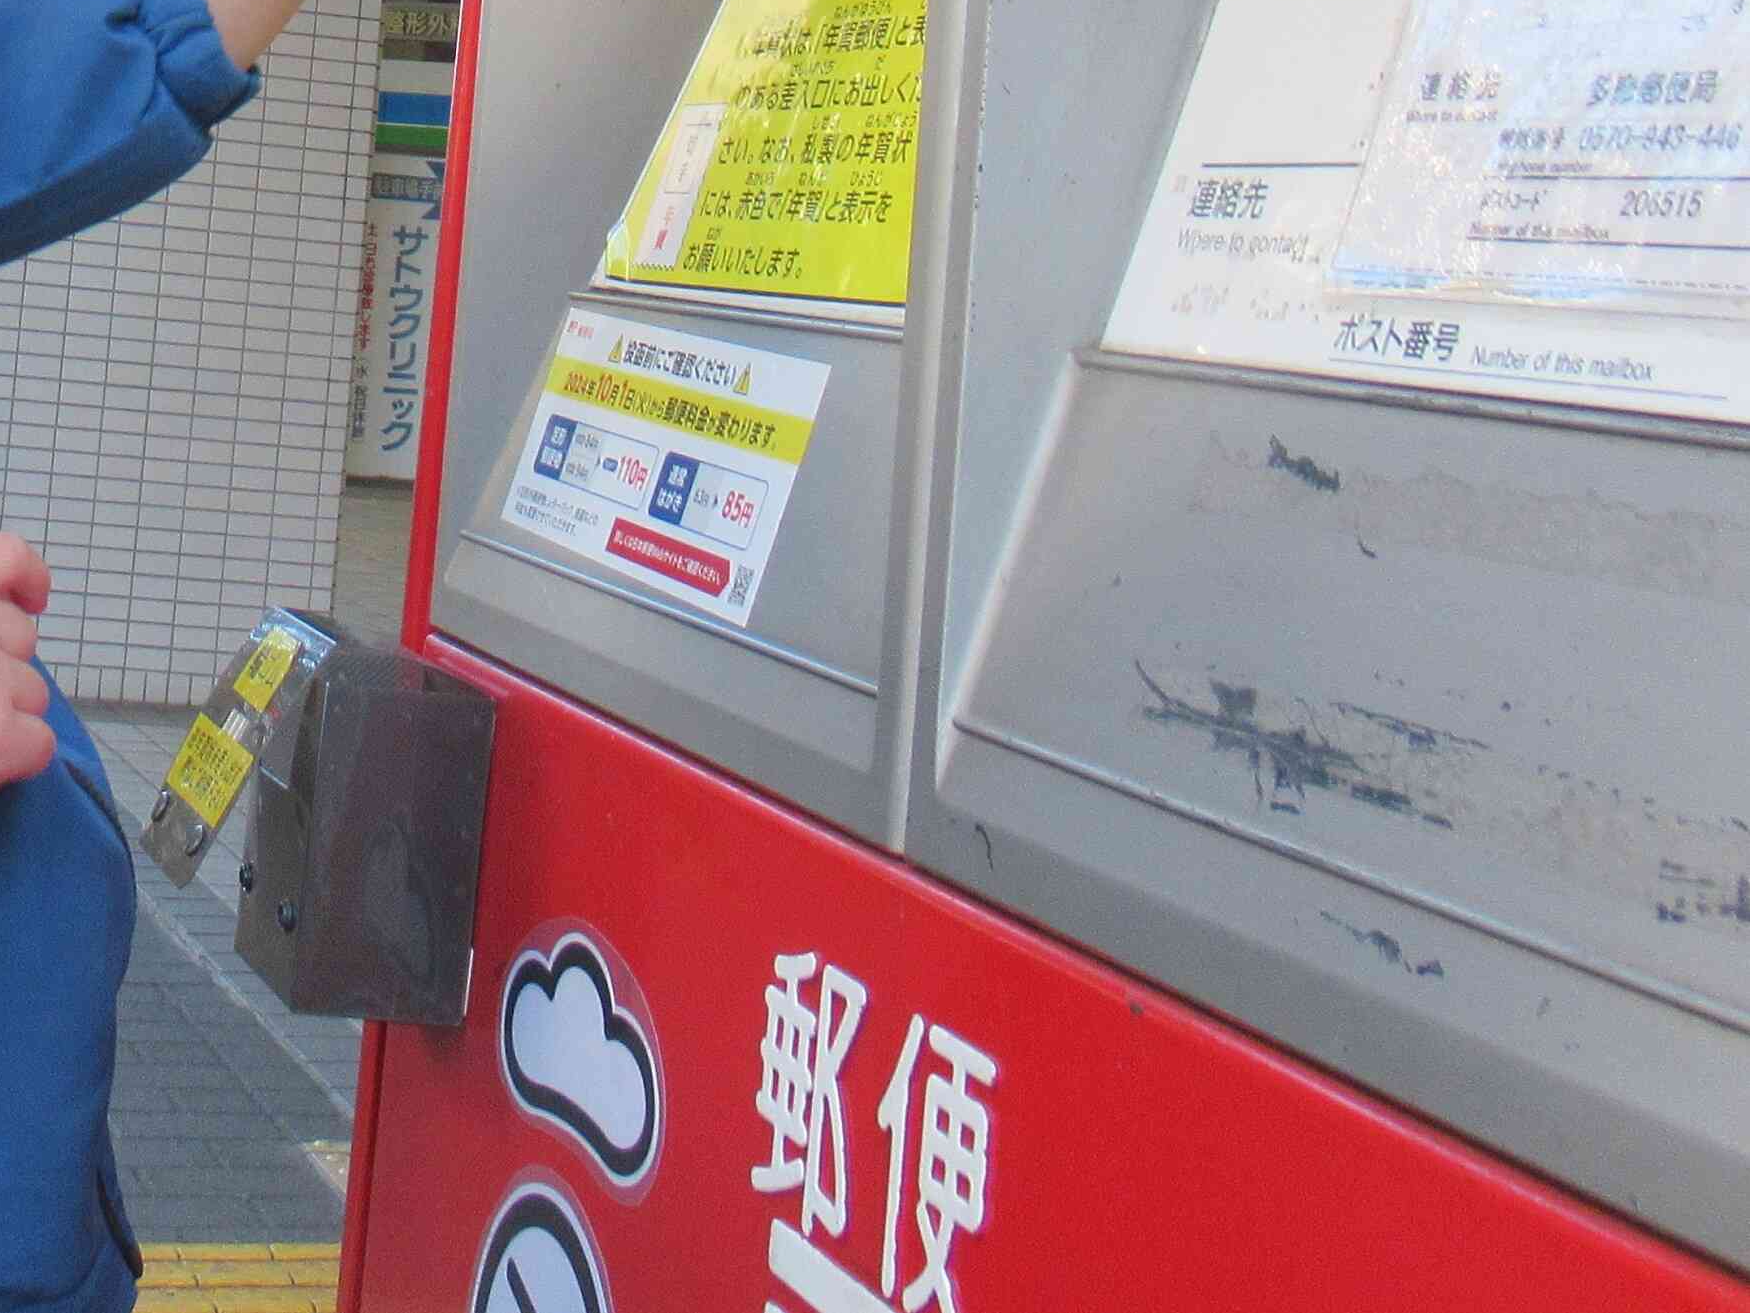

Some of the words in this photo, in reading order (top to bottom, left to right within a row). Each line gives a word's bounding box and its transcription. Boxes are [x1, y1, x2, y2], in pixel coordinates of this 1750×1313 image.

[1188, 177, 1269, 220] 連絡先
[682, 242, 803, 280] お願いいたします。
[380, 224, 429, 452] サトウクリニック
[1332, 312, 1461, 362] ポスト番号
[1471, 344, 1530, 371] Number
[1533, 344, 1553, 373] of
[1554, 351, 1587, 376] this
[1588, 356, 1656, 382] mailbox
[721, 489, 755, 529] 85円
